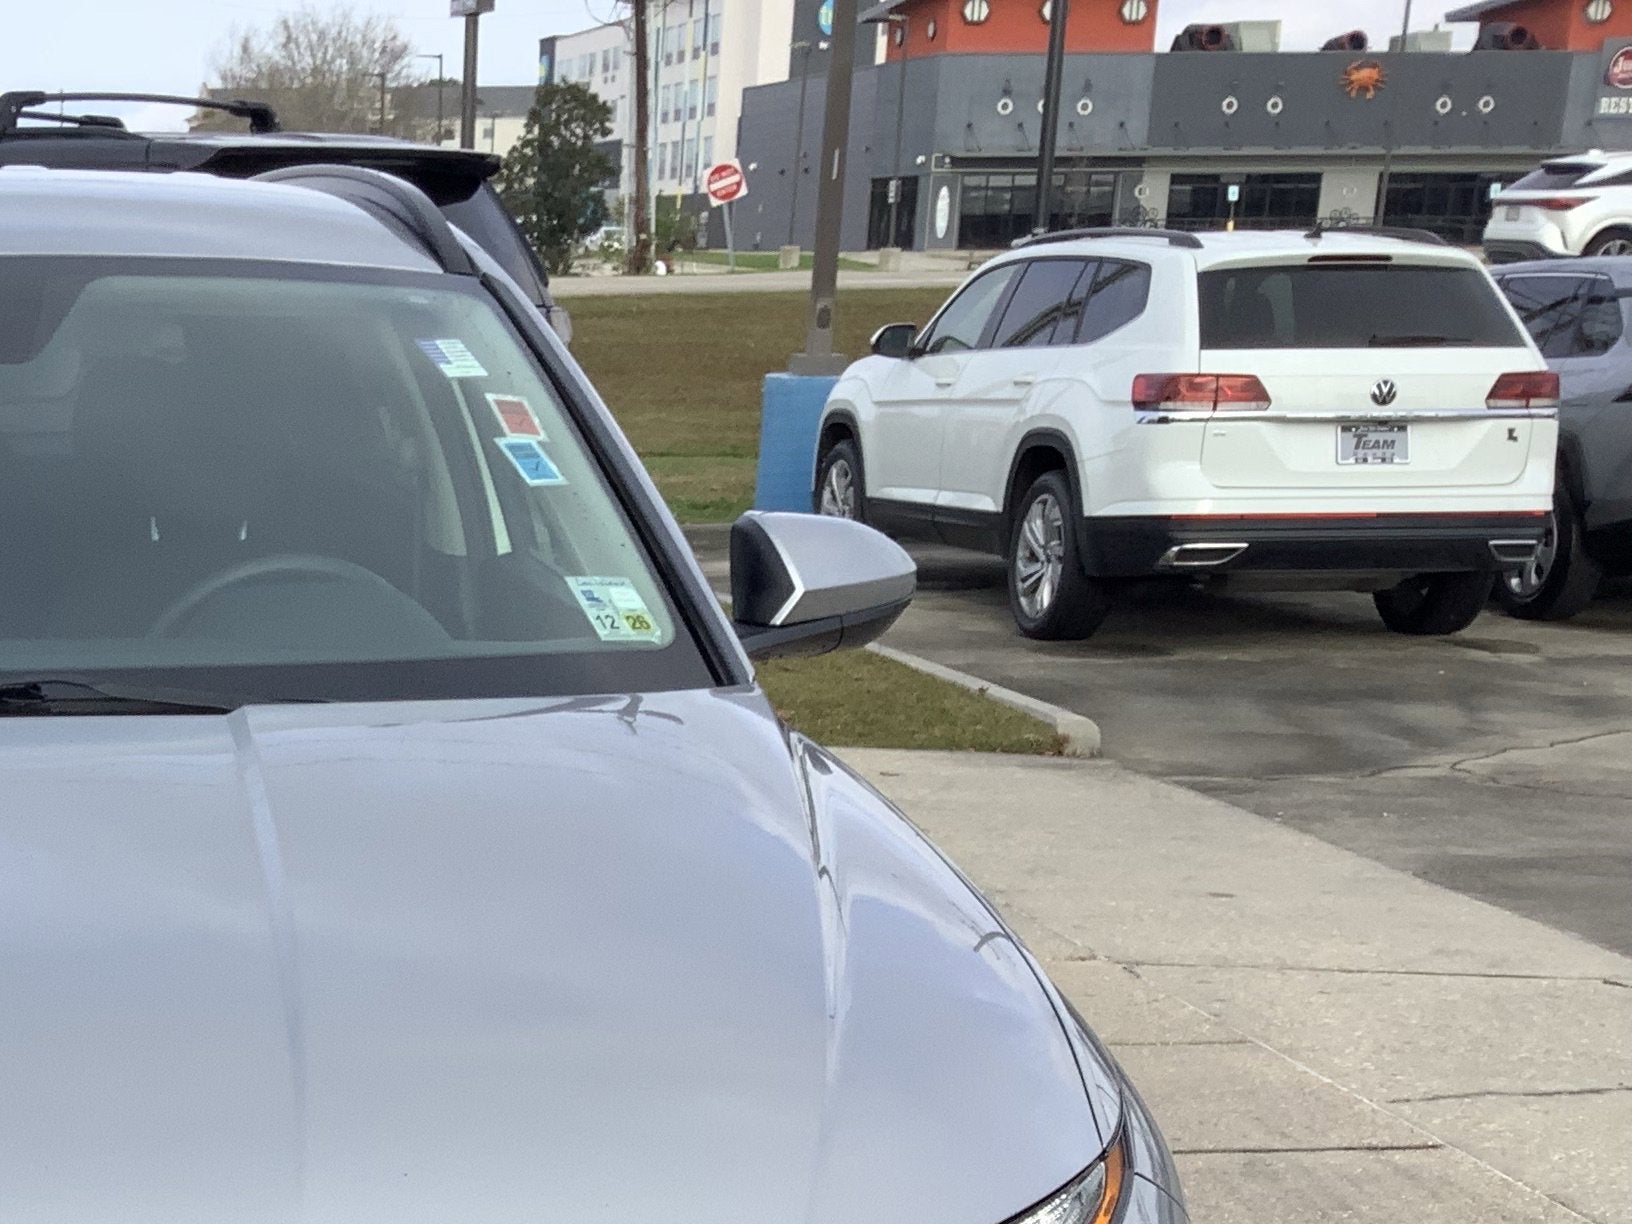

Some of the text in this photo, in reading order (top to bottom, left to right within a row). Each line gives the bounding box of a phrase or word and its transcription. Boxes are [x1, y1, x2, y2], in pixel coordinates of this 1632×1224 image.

[1352, 433, 1396, 450] TEAM
[596, 615, 651, 630] 12 26
